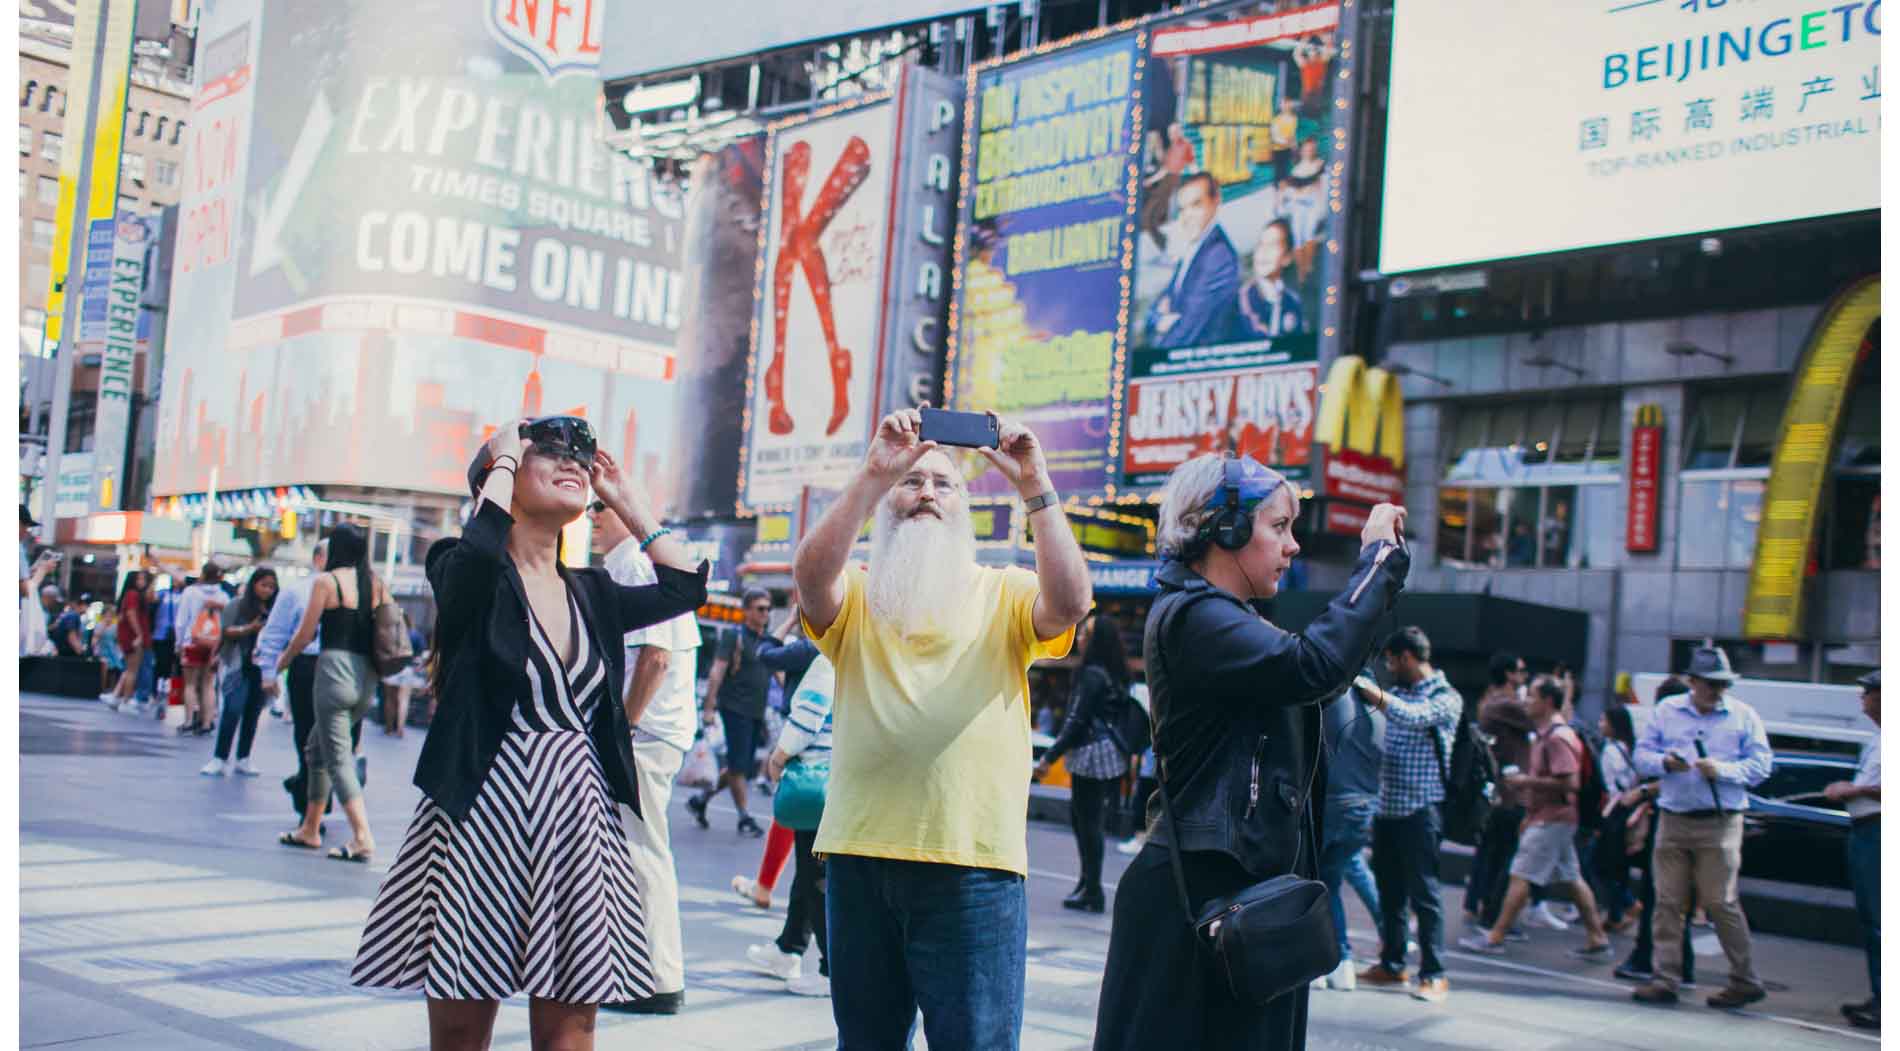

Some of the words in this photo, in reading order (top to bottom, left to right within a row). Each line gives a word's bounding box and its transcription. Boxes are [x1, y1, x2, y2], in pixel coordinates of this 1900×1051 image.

[505, 0, 600, 55] NFL
[978, 102, 1128, 182] BROADWAY
[1730, 117, 1869, 157] INDUSTRIAL
[411, 163, 521, 211] TIMES
[527, 190, 652, 248] SQUARE
[356, 211, 520, 292] COME
[529, 237, 605, 311] ON
[613, 258, 685, 331] IN!
[908, 99, 954, 406] PALACE
[101, 256, 144, 401] EXPERIENCE
[1130, 376, 1235, 441] JERSEY
